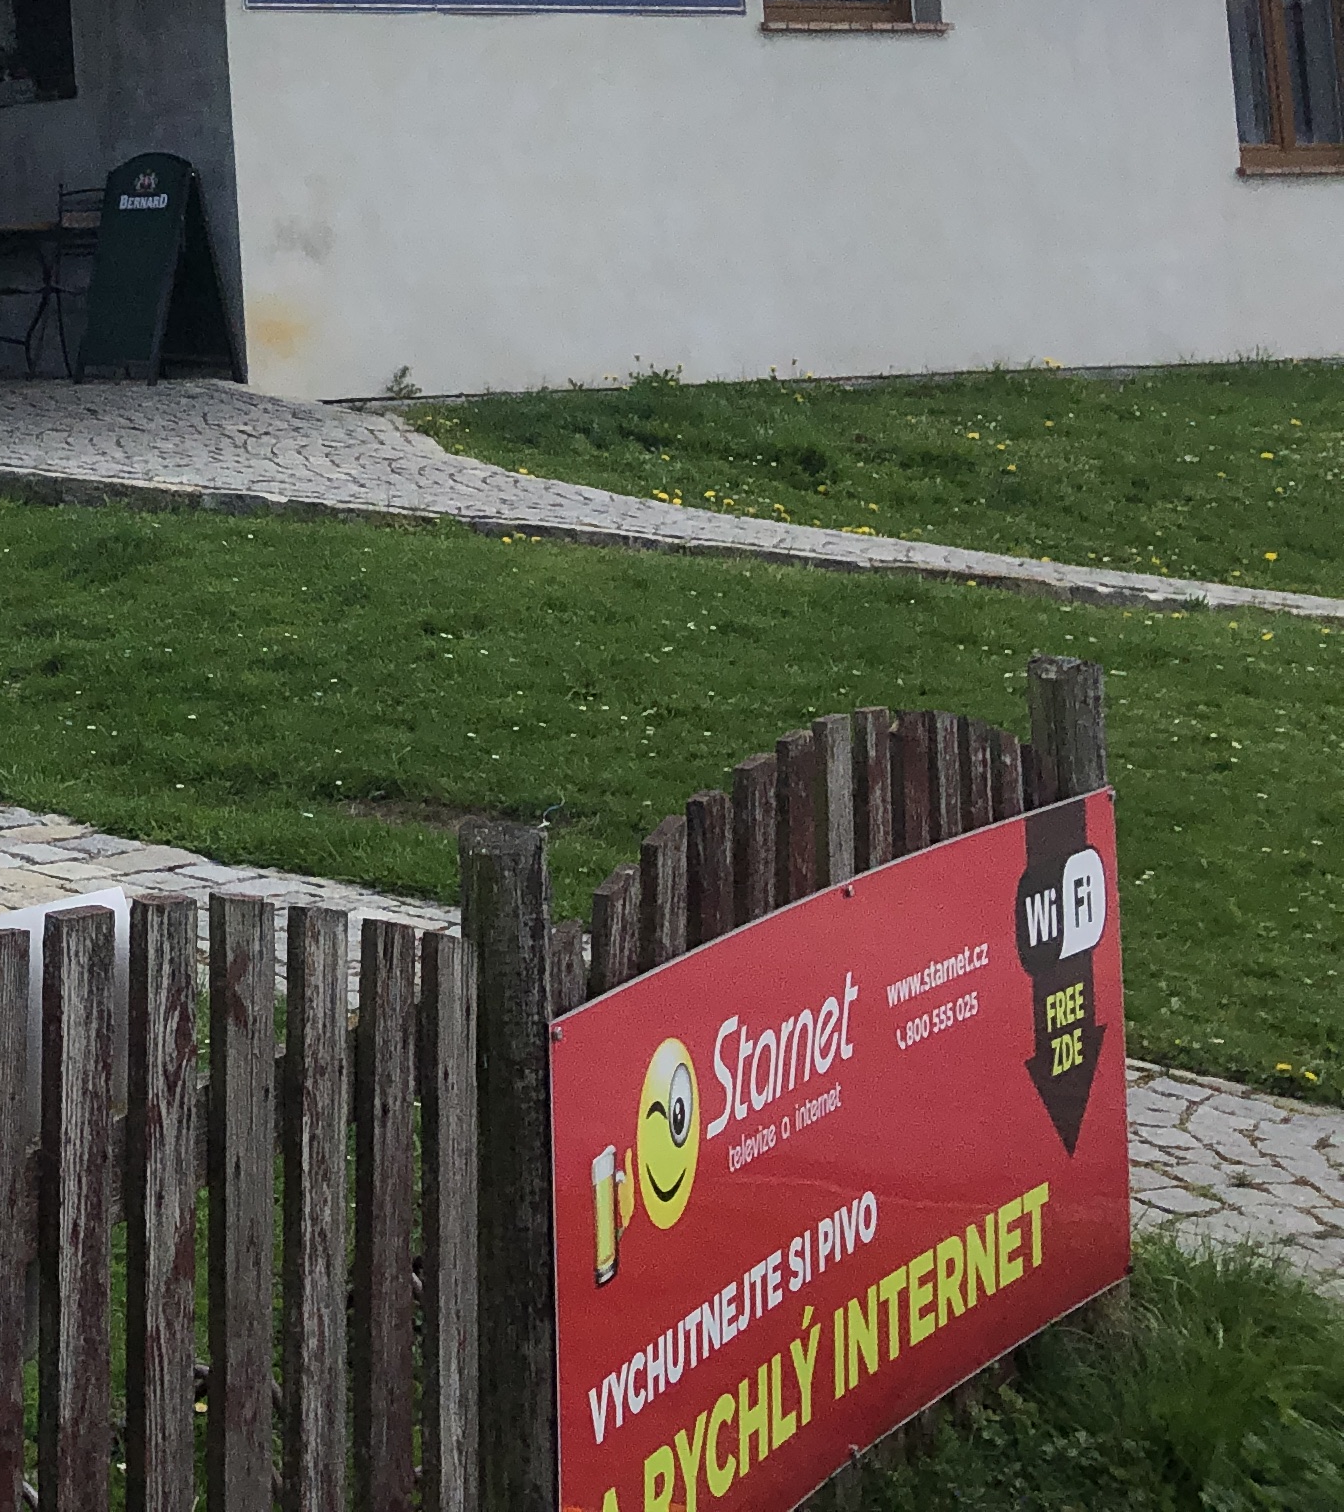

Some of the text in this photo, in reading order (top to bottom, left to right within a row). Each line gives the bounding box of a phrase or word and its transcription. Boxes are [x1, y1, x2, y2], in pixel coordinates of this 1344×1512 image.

[119, 193, 168, 210] BERNARD
[887, 943, 989, 1009] www.starnet.cz
[1046, 982, 1085, 1033] FREE
[906, 991, 979, 1047] 800 555 025
[706, 971, 859, 1139] Starnet
[1051, 1028, 1084, 1077] ZDE
[728, 1082, 842, 1172] televize a internet
[588, 1190, 878, 1445] VYCHUTNEJTE SI PIVO
[834, 1181, 1050, 1400] INTERNET
